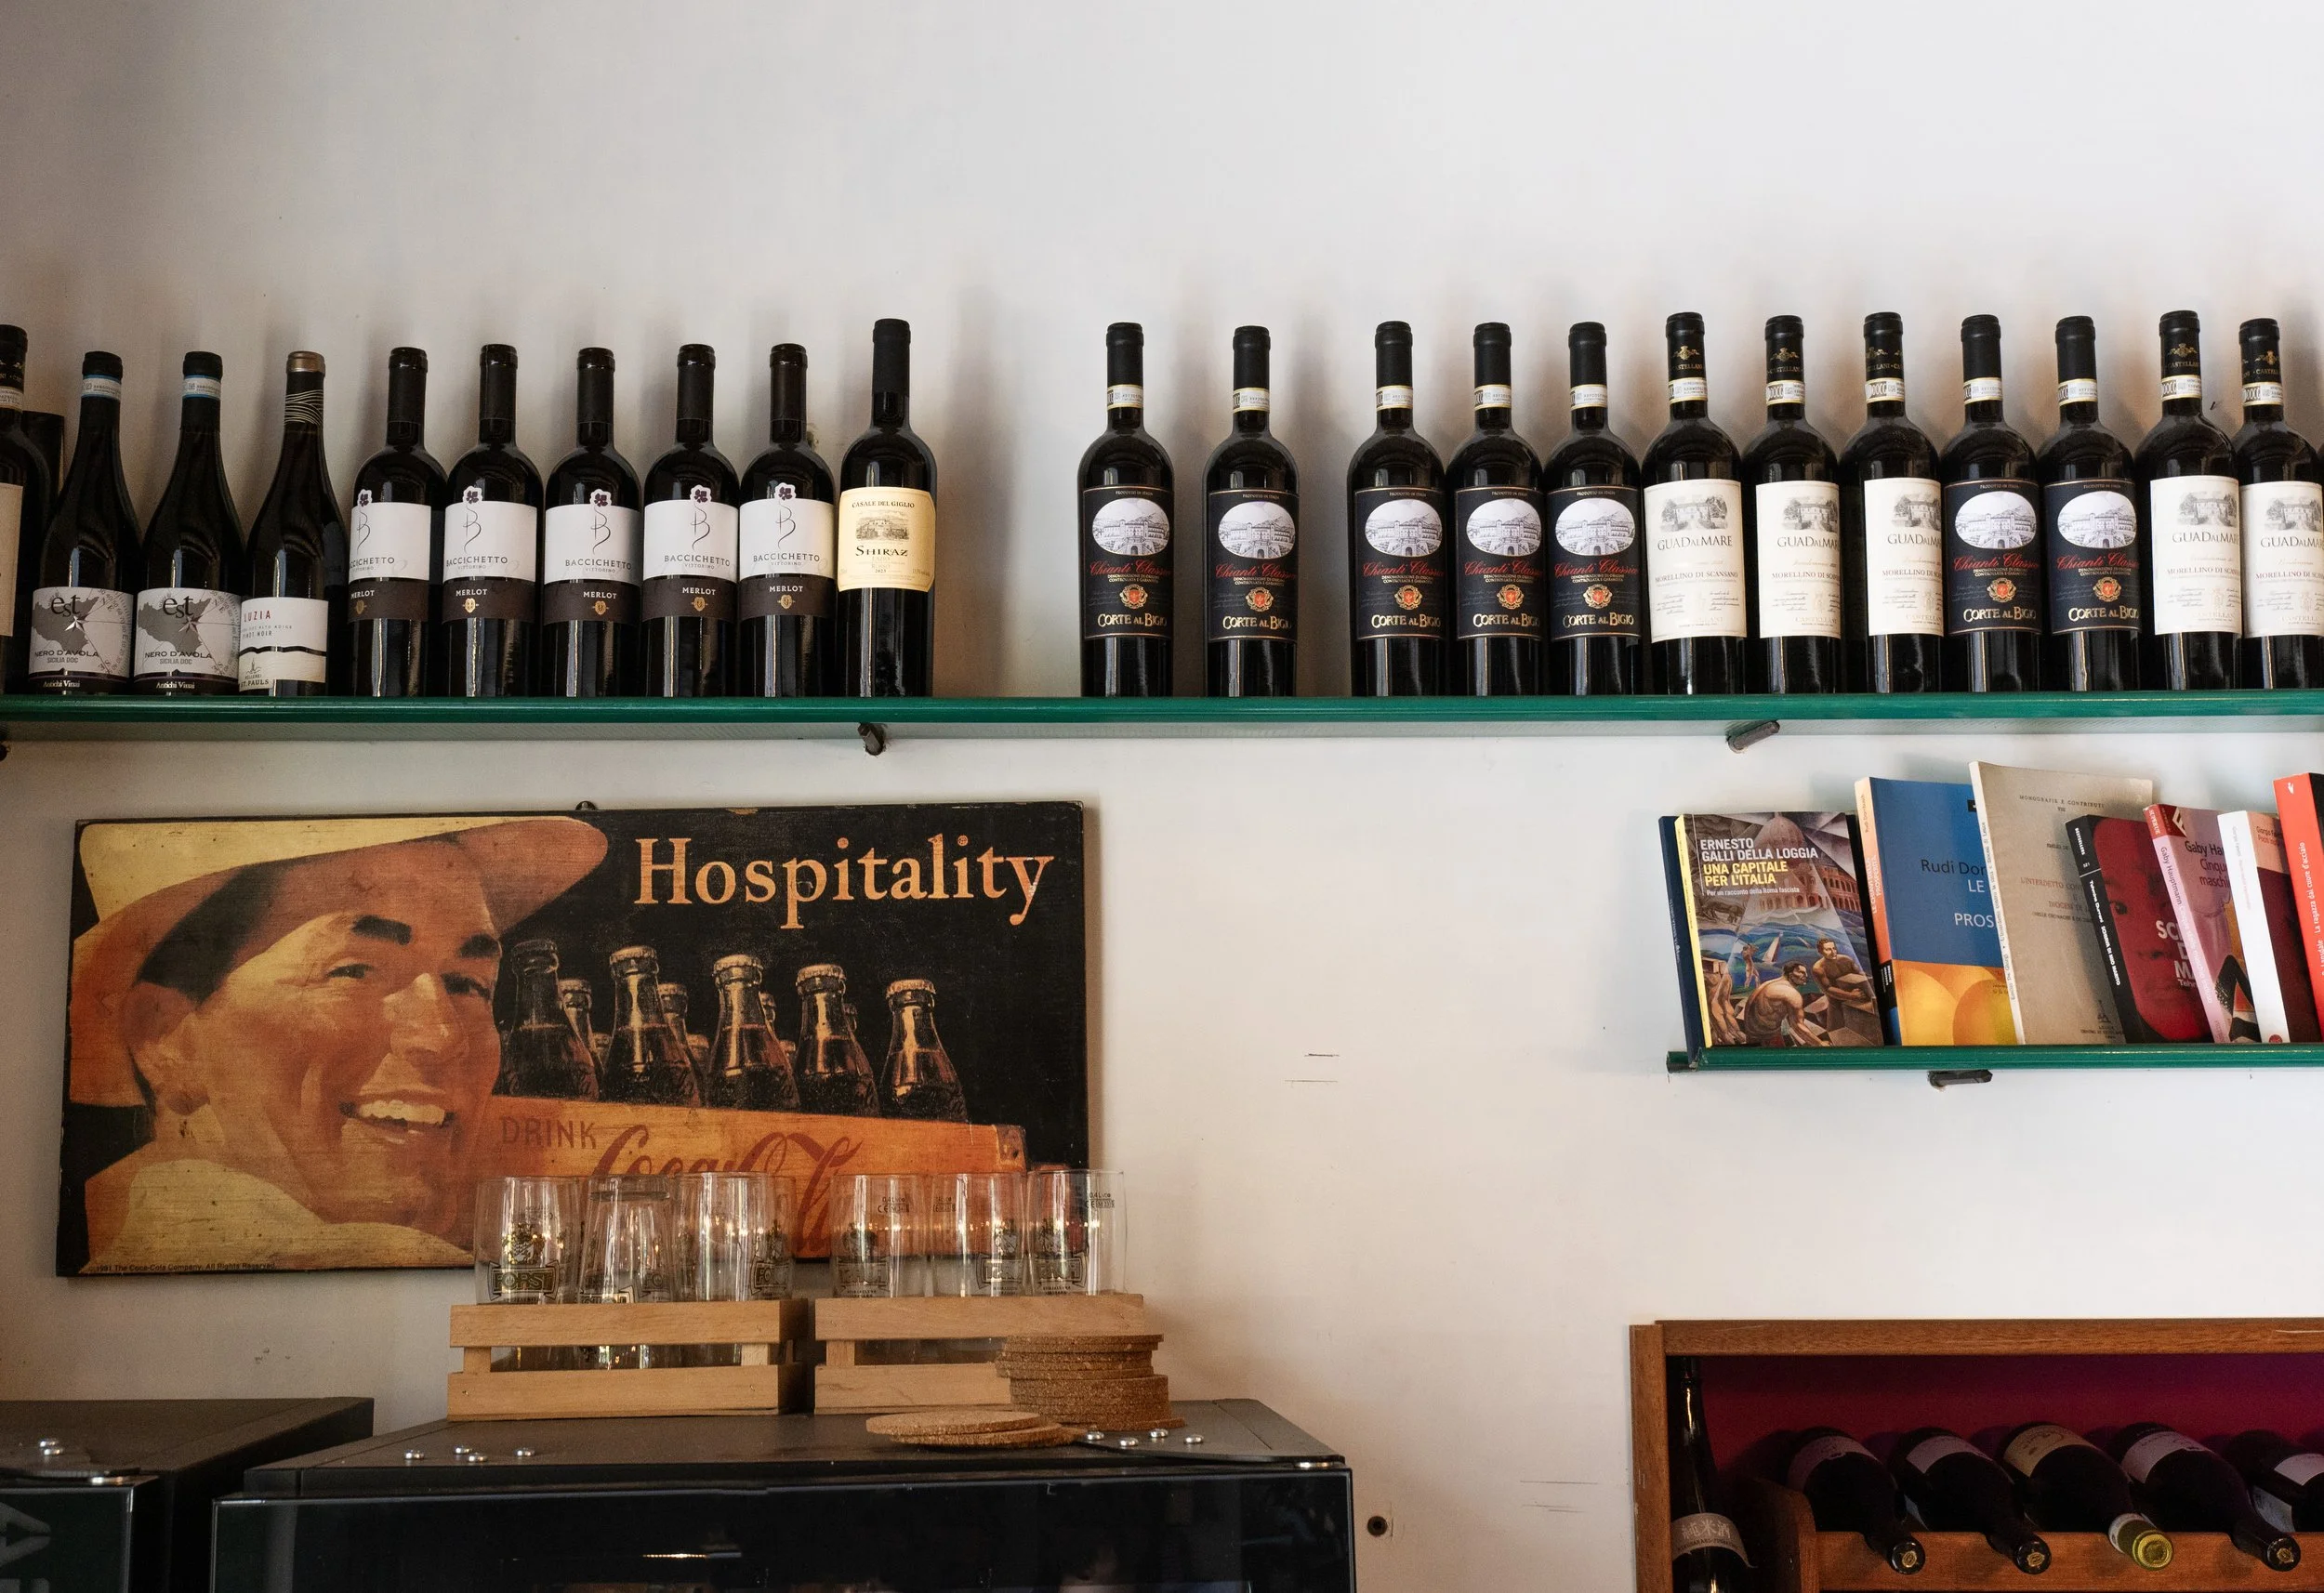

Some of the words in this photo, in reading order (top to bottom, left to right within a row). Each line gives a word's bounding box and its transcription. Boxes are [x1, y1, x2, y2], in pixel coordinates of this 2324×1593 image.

[852, 500, 877, 508] CASALE
[445, 555, 508, 567] BACCICHETTO
[664, 552, 731, 567] BACCICHETTO
[753, 552, 821, 562] BACCICHETTO
[1954, 556, 2000, 572] Chianti
[2057, 555, 2104, 570] Chianti
[564, 558, 632, 571] BACCICHETTO
[1089, 560, 1134, 576] Chianti
[1215, 563, 1260, 577] Chianti
[1363, 561, 1406, 576] Chianti
[1464, 560, 1508, 576] Chianti
[1554, 561, 1595, 577] Chianti
[1655, 572, 1693, 583] MORELLINO
[1772, 571, 1816, 579] MORELLINO
[1882, 568, 1925, 576] MORELLINO
[2255, 570, 2302, 579] MORELLINO
[350, 589, 376, 599] MERLOT
[456, 587, 488, 597] MERLOT
[583, 590, 617, 599] MERLOT
[681, 586, 717, 596] MERLOT
[769, 584, 804, 593] MERLOT
[51, 595, 81, 617] est
[163, 596, 193, 618] est
[244, 610, 271, 623] LUZIA
[1098, 613, 1131, 627] CORTE
[1371, 614, 1406, 628] CORTE
[1472, 613, 1509, 627] CORTE
[1511, 617, 1521, 625] AL
[1563, 614, 1596, 628] CORTE
[1598, 616, 1608, 625] AL
[1609, 612, 1634, 626] BIGIO
[1963, 608, 2000, 623] CORTE
[2002, 610, 2013, 619] AL
[2068, 607, 2106, 622] CORTE
[2108, 610, 2119, 618] AL
[1222, 615, 1257, 629] CORTE
[170, 651, 213, 659] D'AVOLA
[2020, 795, 2058, 804] MONOGRAFIE
[2067, 800, 2105, 809] CONTRIBUTI
[1700, 837, 1754, 850] ERNESTO
[2075, 827, 2085, 855] BESTSELLERS
[1702, 850, 1734, 862] GALLI
[1737, 849, 1774, 861] DELLA
[1776, 847, 1818, 859] LOGGIA
[2185, 840, 2208, 857] Gaby
[2299, 841, 2309, 869] d'acciaio
[1703, 863, 1729, 875] UNA
[1732, 861, 1789, 875] CAPITALE
[1921, 859, 1954, 874] Rudi
[634, 833, 1055, 929] Hospitality
[1705, 875, 1728, 887] PER
[1731, 873, 1776, 886] L'ITALIA
[2160, 847, 2170, 864] Gaby
[2167, 865, 2183, 905] Hauptmann
[2304, 871, 2313, 888] cuore
[1968, 879, 1985, 893] LE
[2307, 889, 2316, 901] dal
[1954, 913, 1994, 928] PROS
[2310, 901, 2320, 926] ragazza
[2316, 925, 2322, 934] La
[2112, 965, 2121, 986] MARITO
[502, 1116, 598, 1150] DRINK
[217, 1262, 240, 1270] Rights
